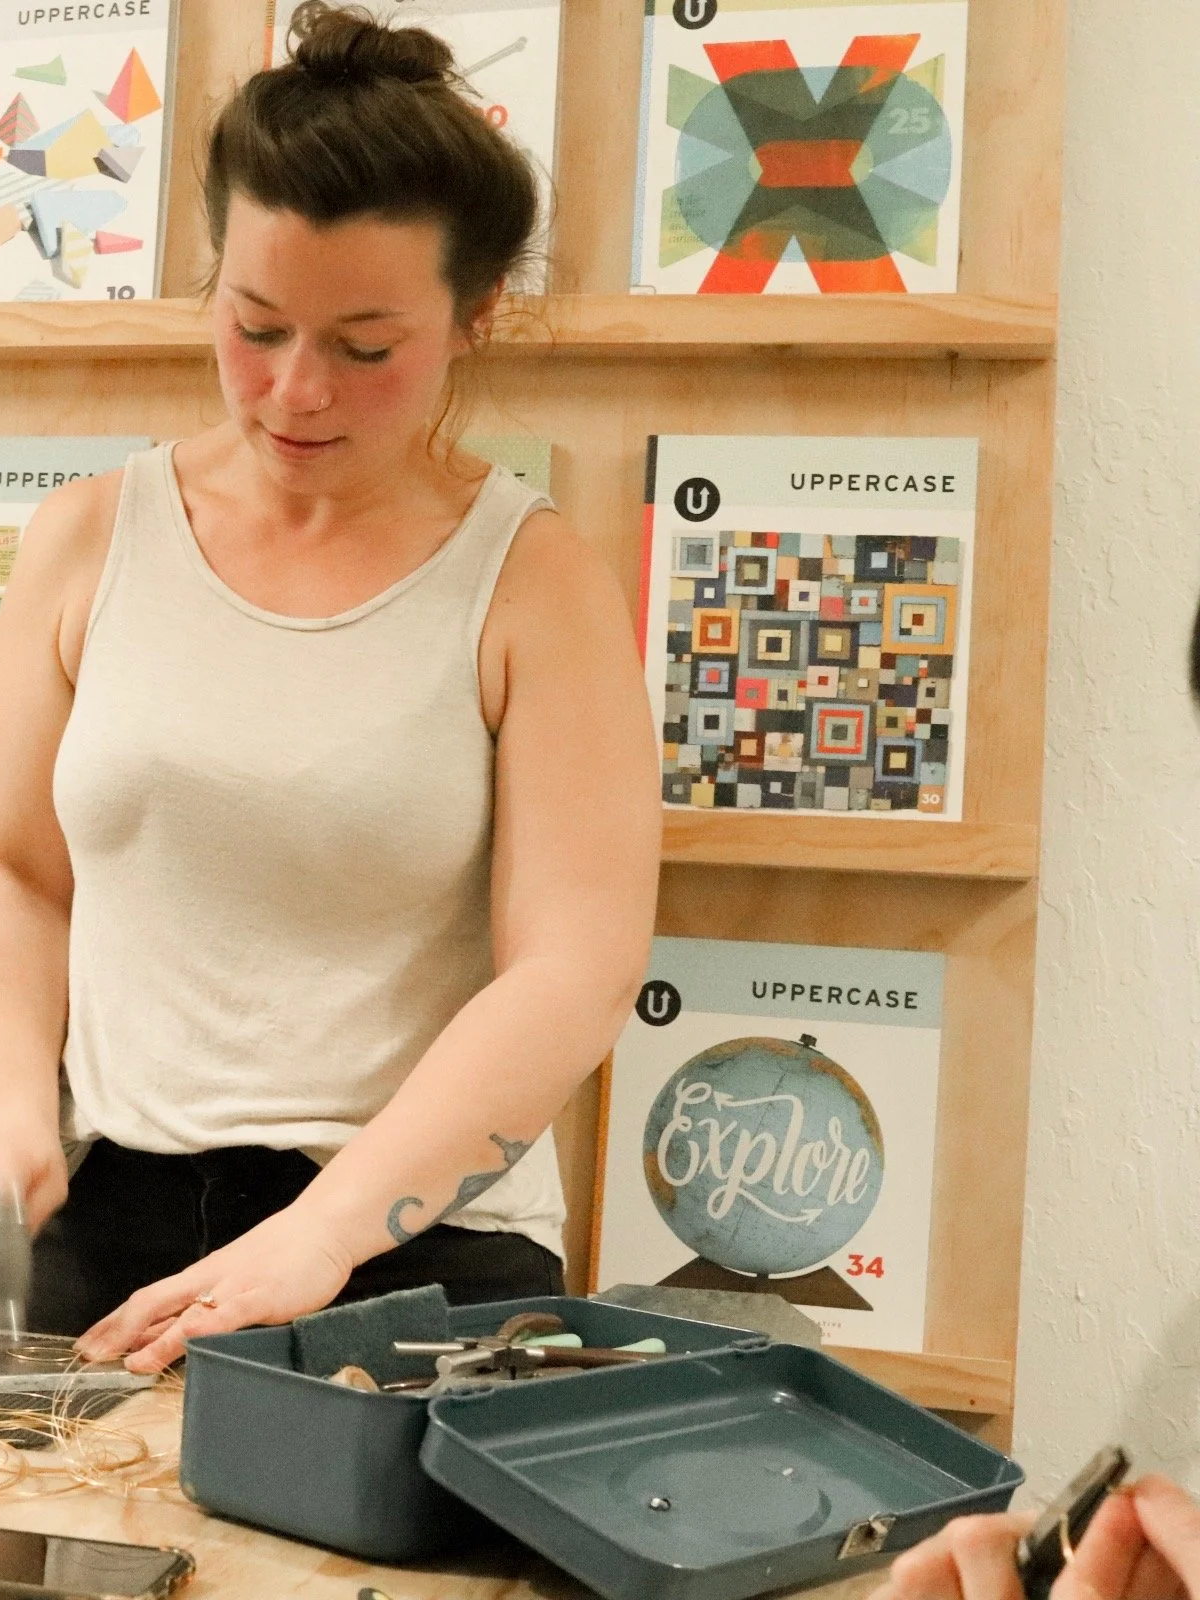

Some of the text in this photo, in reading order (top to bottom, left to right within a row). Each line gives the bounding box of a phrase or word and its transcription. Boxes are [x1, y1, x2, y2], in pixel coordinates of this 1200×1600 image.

[18, 0, 150, 25] UPPERCASE
[887, 107, 931, 134] 25
[790, 473, 955, 493] UPPERCASE
[921, 793, 941, 804] 30
[752, 981, 918, 1009] UPPERCASE
[657, 1078, 871, 1224] Explore
[846, 1254, 884, 1278] 34
